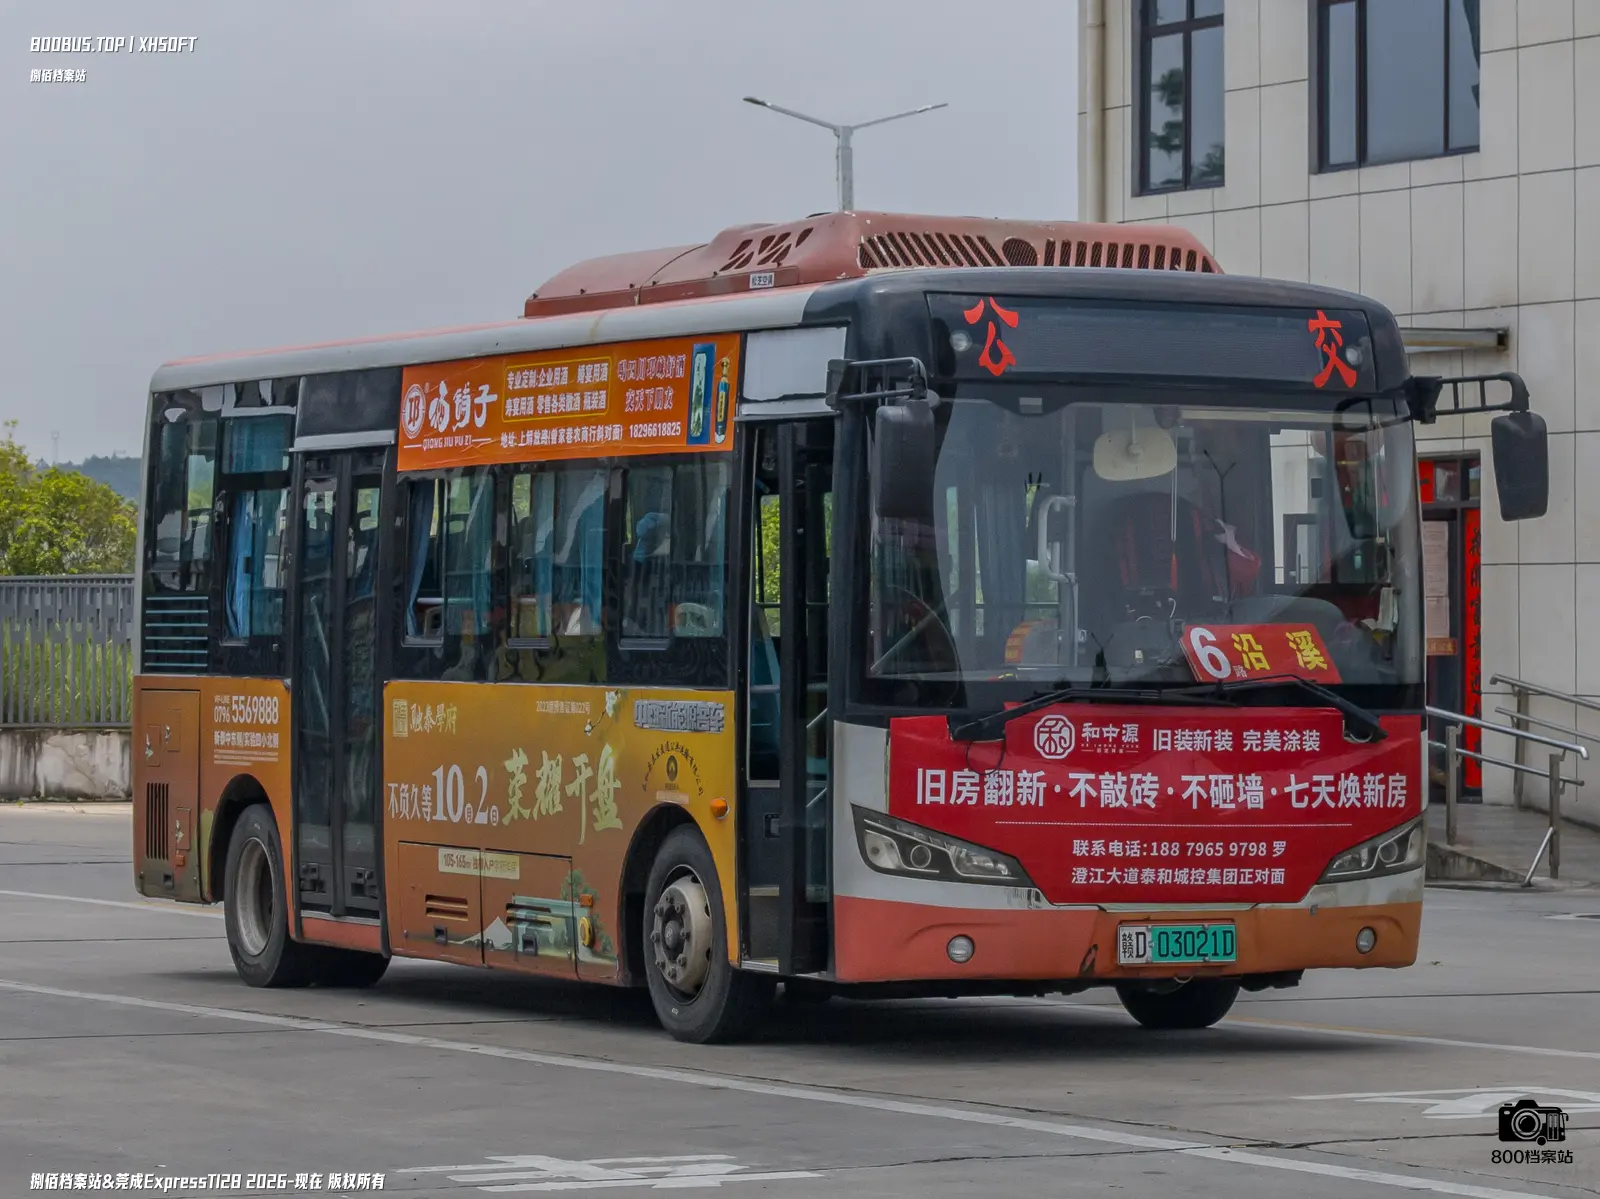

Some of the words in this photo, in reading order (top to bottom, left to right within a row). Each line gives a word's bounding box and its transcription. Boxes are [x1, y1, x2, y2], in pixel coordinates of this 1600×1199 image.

[963, 296, 1019, 377] 公
[1308, 310, 1357, 389] 交
[444, 436, 454, 448] JIU
[454, 435, 464, 447] PU
[1189, 627, 1232, 679] 6
[213, 705, 231, 724] 0796
[231, 695, 279, 725] 5569888
[1081, 722, 1140, 744] 和中源
[1152, 728, 1233, 752] 旧装新装
[1242, 728, 1321, 753] 完美涂装
[1185, 840, 1225, 858] 7965
[1228, 840, 1268, 858] 9798
[1272, 840, 1287, 858] 罗
[1071, 867, 1286, 887] 澄江大道泰和城控集团正对面
[1157, 929, 1235, 958] 03021D
